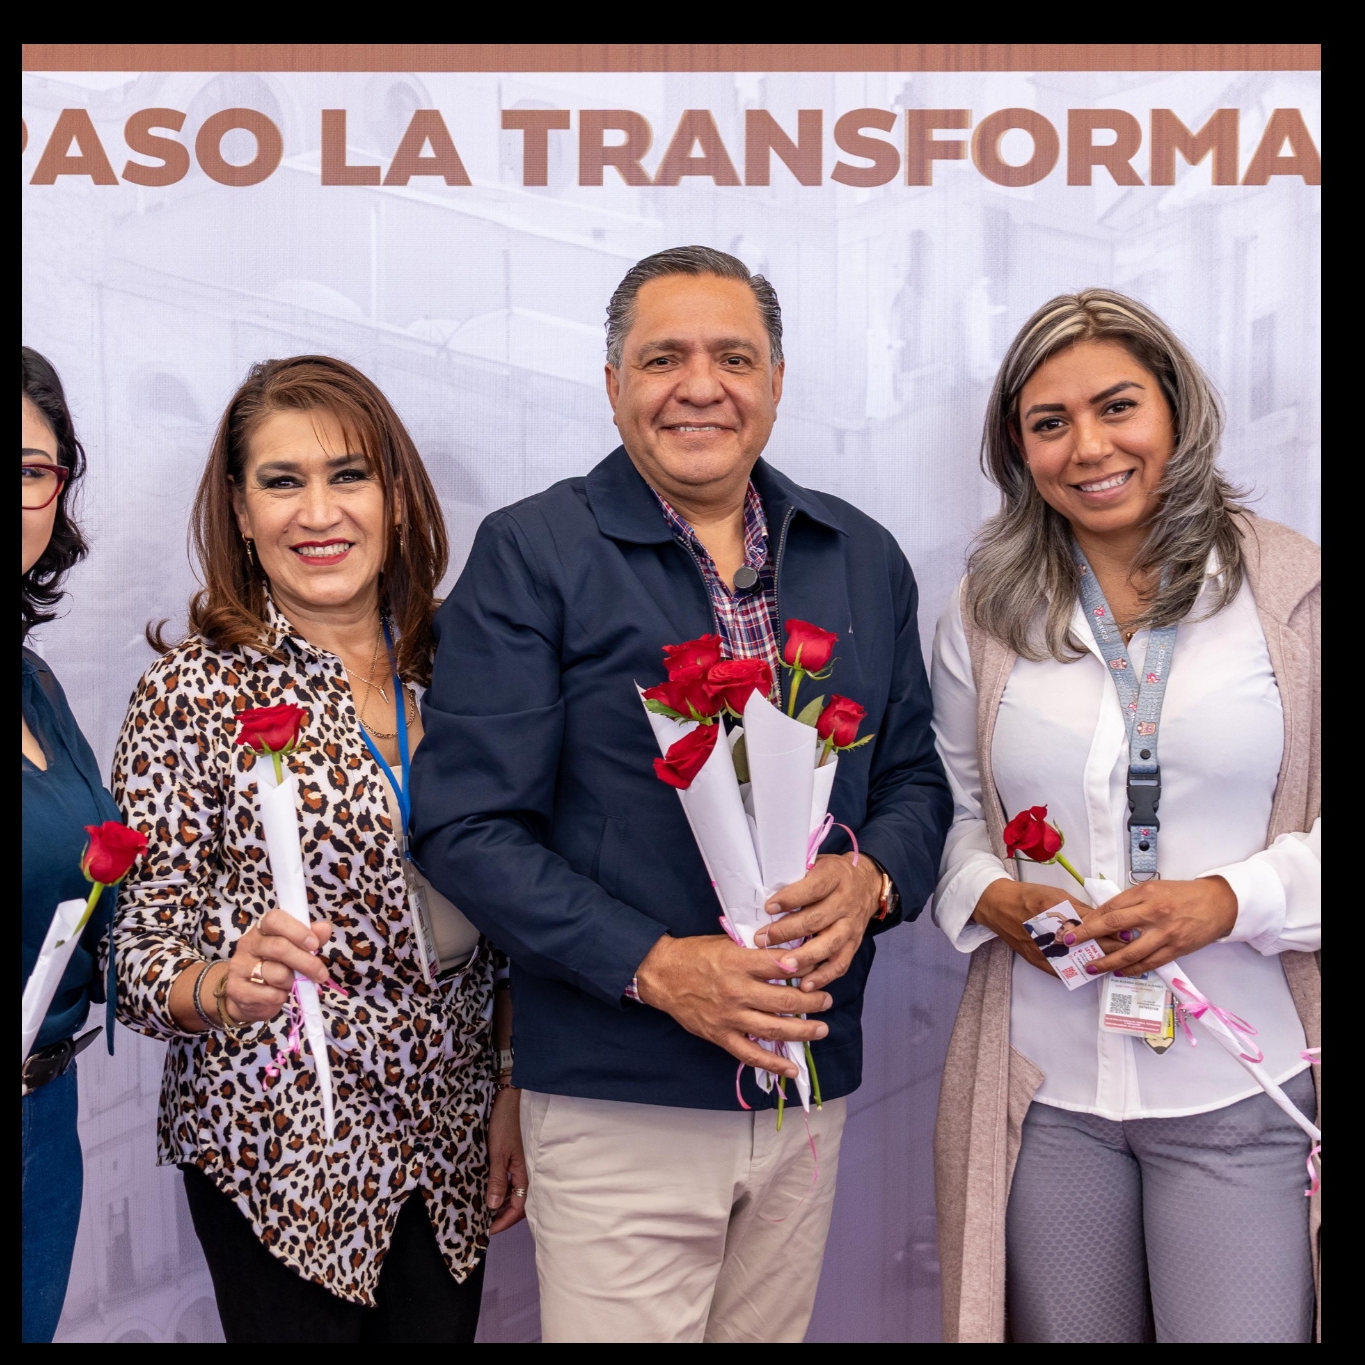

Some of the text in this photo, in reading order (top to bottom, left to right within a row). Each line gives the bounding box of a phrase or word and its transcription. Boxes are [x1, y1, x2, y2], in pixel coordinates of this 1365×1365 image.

[22, 106, 1321, 188] ASO LA TRANSFORMA
